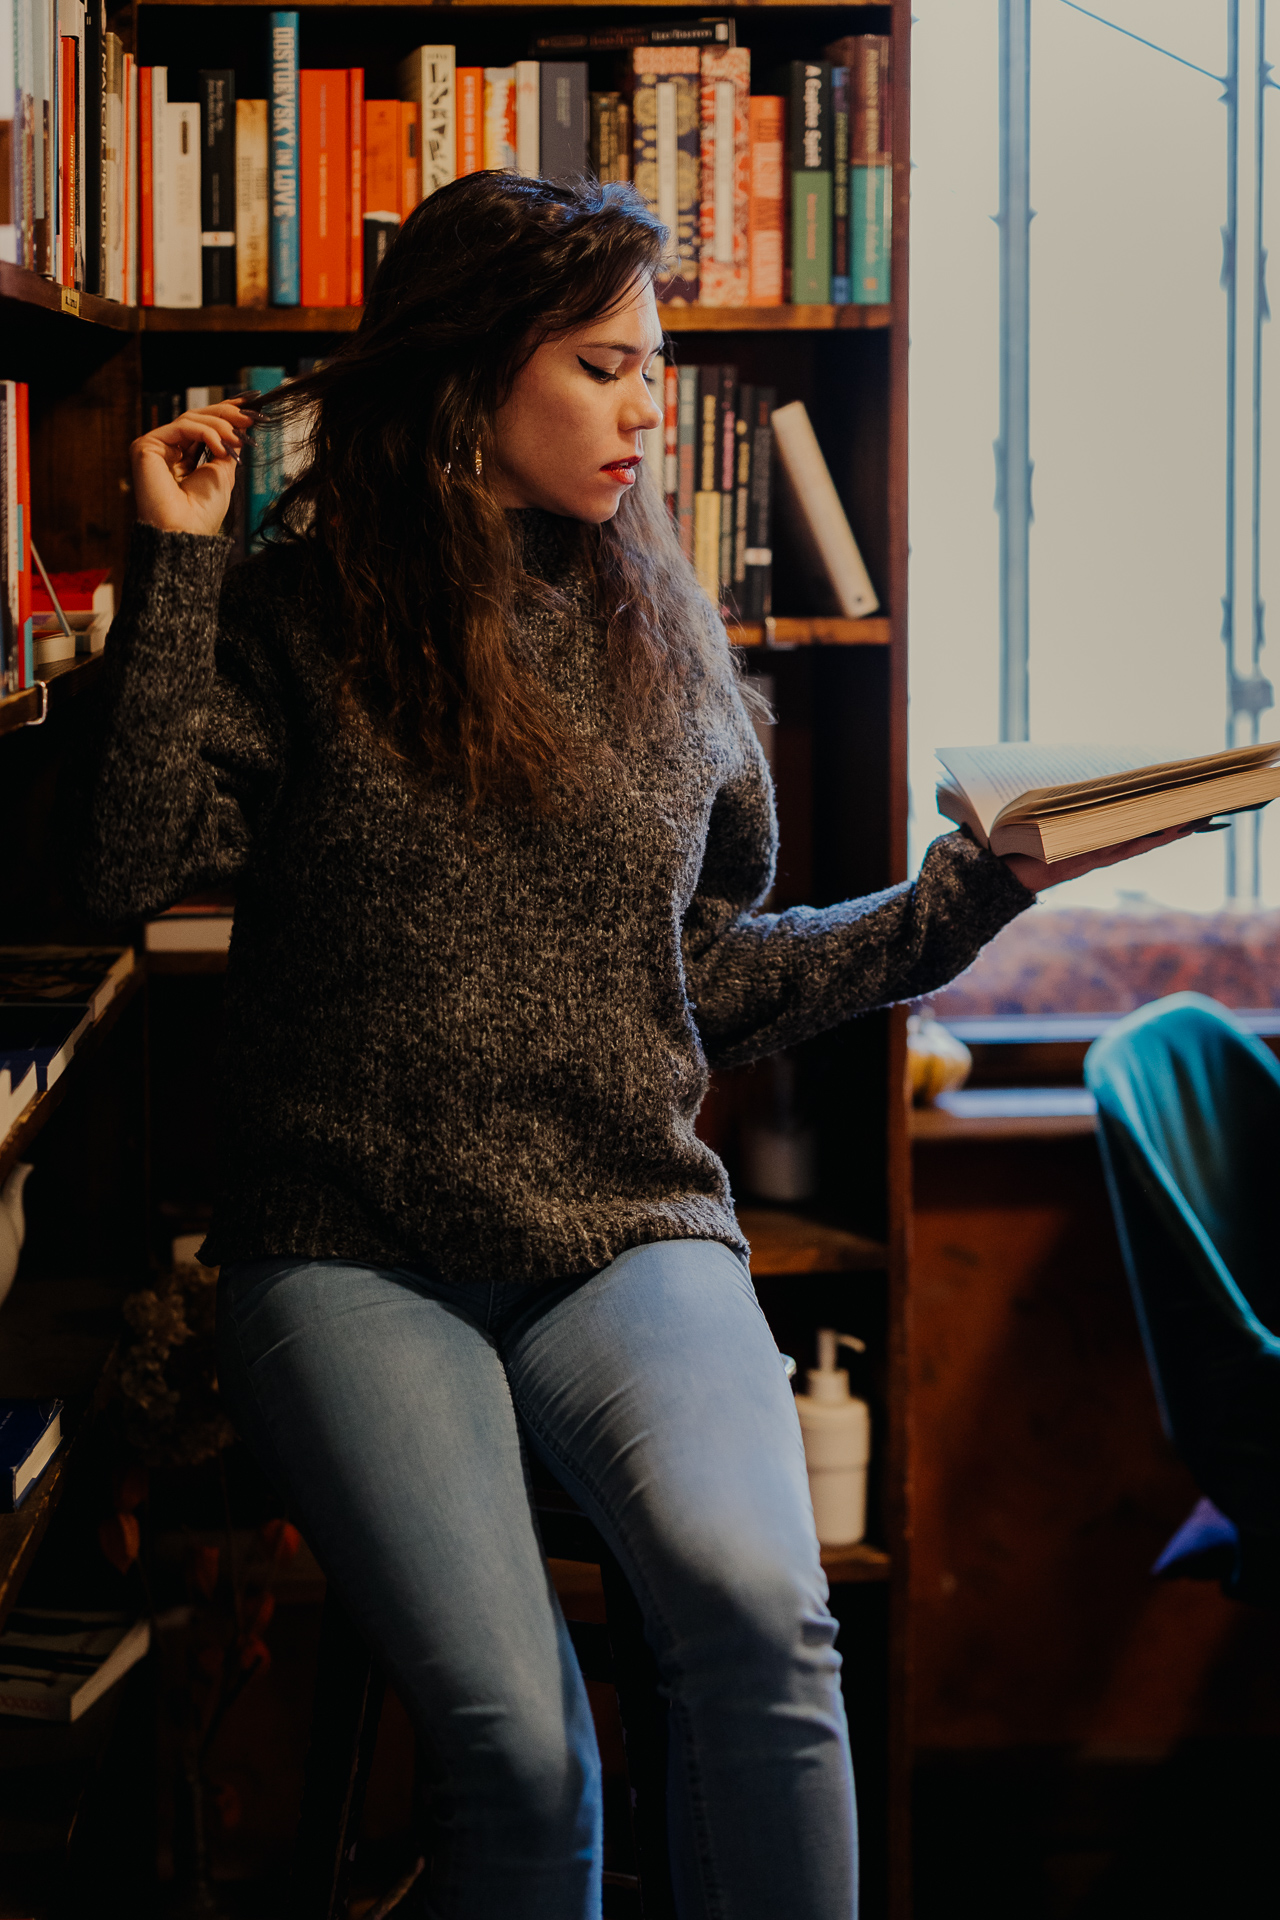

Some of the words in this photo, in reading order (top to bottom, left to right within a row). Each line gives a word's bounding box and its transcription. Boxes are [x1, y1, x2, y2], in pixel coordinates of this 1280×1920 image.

[273, 27, 295, 146] DOSTOEVSKY
[805, 65, 821, 77] A
[803, 78, 821, 128] Captive
[275, 149, 294, 166] IN
[803, 129, 821, 167] Spirit
[273, 169, 296, 217] LOVE
